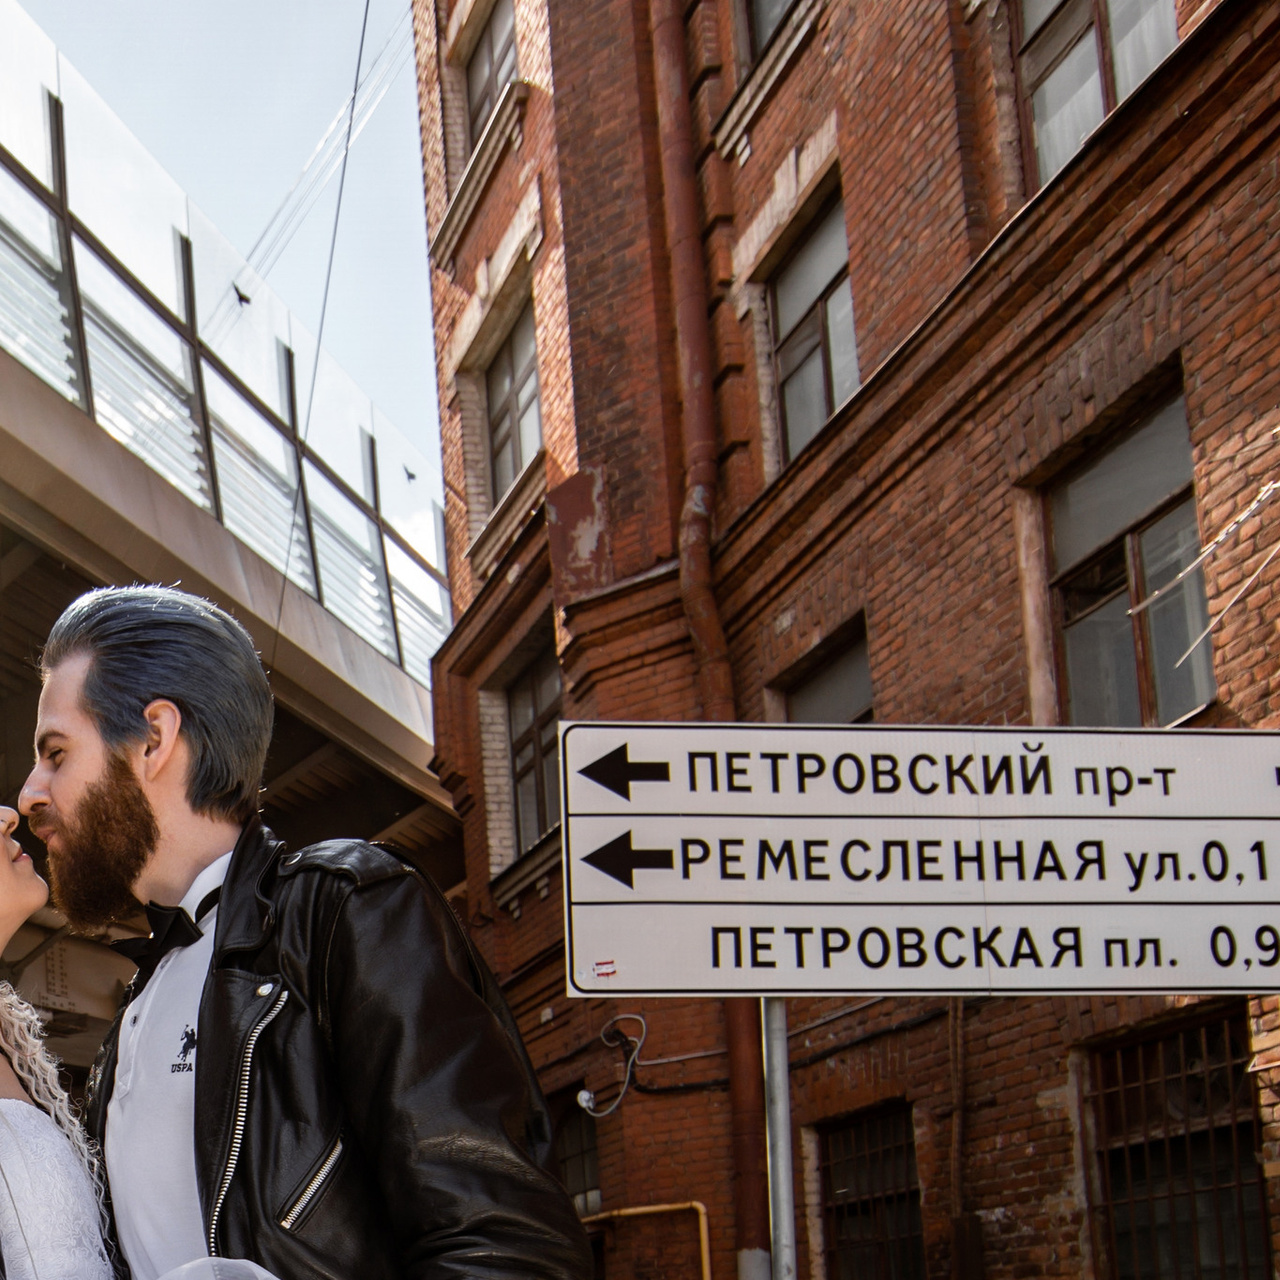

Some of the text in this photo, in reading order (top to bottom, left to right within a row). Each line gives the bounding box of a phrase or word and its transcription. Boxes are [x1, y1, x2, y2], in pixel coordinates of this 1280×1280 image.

[687, 742, 1176, 807] ПЕТРОВСКИЙ пр-т
[680, 838, 1106, 882] РЕМЕСЛЕННАЯ
[711, 924, 1280, 971] ПЕТРОВСКАЯ пл. 0,9
[171, 1063, 193, 1073] USPA
